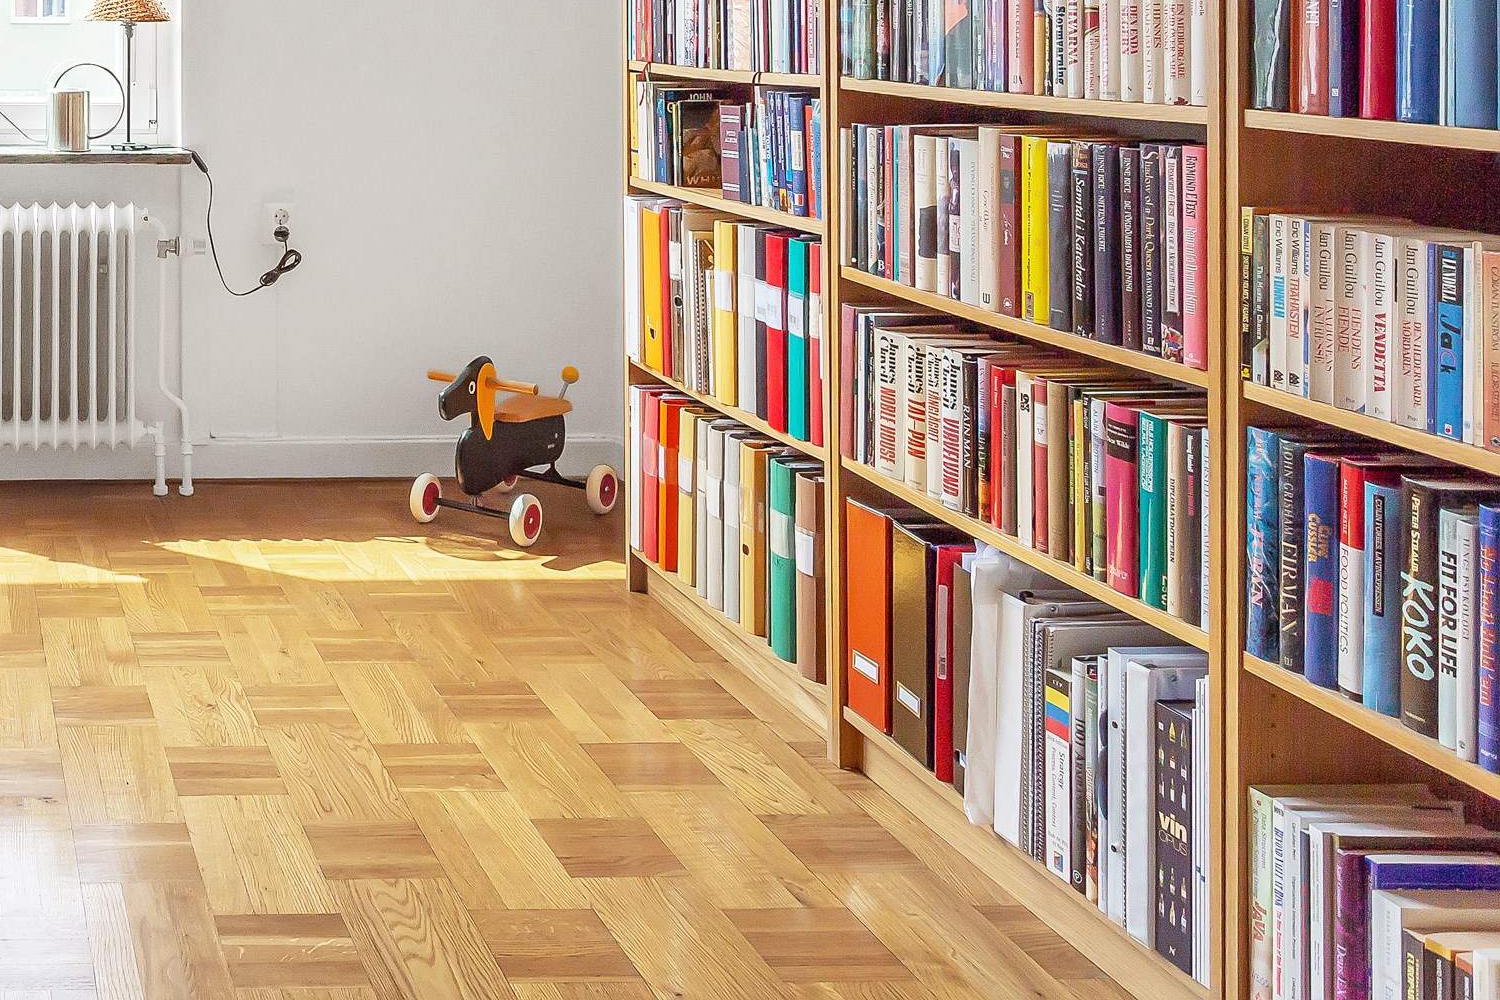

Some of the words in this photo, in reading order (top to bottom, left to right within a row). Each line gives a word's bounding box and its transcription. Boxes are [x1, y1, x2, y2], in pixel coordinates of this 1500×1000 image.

[1128, 5, 1138, 26] DEN
[1152, 8, 1162, 48] HENNES
[1176, 3, 1184, 16] EN
[1054, 6, 1066, 86] Stormvarning
[1128, 28, 1138, 54] ENDA
[1176, 18, 1184, 79] MEDBORGARE
[688, 93, 712, 101] JOHN
[1140, 150, 1158, 194] Shadow
[1184, 156, 1198, 192] RAYMOND
[1075, 177, 1086, 224] Samtal
[1144, 195, 1156, 208] of
[1184, 200, 1198, 218] FEIST
[1144, 216, 1156, 240] Dark
[1274, 220, 1283, 238] Eric
[1290, 220, 1300, 238] Eric
[1319, 229, 1332, 248] Jan
[1344, 230, 1358, 250] Jan
[1144, 241, 1156, 271] Queen
[1274, 238, 1283, 274] Williams
[1290, 238, 1300, 274] Williams
[1374, 238, 1386, 258] Jan
[1406, 245, 1419, 264] Jan
[1075, 234, 1086, 301] Katedralen
[1256, 265, 1264, 279] The
[1319, 248, 1332, 290] Guillou
[1344, 252, 1358, 298] Guillou
[1374, 260, 1386, 306] Guillou
[1441, 258, 1456, 302] LUNDELL
[1256, 281, 1264, 302] Music
[1274, 275, 1284, 318] TUNNELN
[1290, 276, 1300, 338] TRÄHÄSTEN
[1406, 268, 1419, 314] Guillou
[1256, 314, 1264, 340] Chance
[1314, 304, 1324, 364] INTRESSE
[1338, 304, 1350, 352] FIENDE
[1351, 307, 1362, 370] FIENDENS
[1414, 321, 1422, 342] DEN
[888, 338, 900, 384] James
[915, 347, 926, 394] James
[934, 354, 942, 388] James
[1374, 312, 1386, 393] VENDETTA
[950, 358, 960, 410] James
[880, 386, 896, 424] NOBLE
[963, 405, 971, 437] RAIN
[880, 426, 896, 465] HOUSE
[942, 417, 960, 498] VIRVELVIND
[963, 438, 971, 469] MAN
[1253, 430, 1264, 462] JOHN
[1283, 446, 1294, 478] JOHN
[1253, 464, 1264, 520] GRISHAM
[1283, 482, 1294, 535] GRISHAM
[1374, 498, 1384, 522] COLIN
[1411, 496, 1422, 528] PETER
[1308, 513, 1319, 562] CUSSLER
[1411, 530, 1422, 572] STRAUB
[1250, 527, 1264, 608] JURYN
[1340, 547, 1348, 593] FOOD
[1441, 550, 1458, 582] FIT
[1480, 544, 1496, 570] No
[1281, 540, 1298, 636] FIRMAN
[1462, 574, 1470, 640] PSYKOLOGI
[1480, 574, 1496, 624] Limit
[1340, 596, 1348, 654] POLITICS
[1400, 570, 1436, 681] KOKO
[1441, 585, 1458, 632] FOR
[1441, 635, 1458, 678] LIFE
[1480, 629, 1496, 706] Hold'em
[1074, 716, 1086, 746] 1001
[1057, 750, 1066, 790] Strategy
[1158, 810, 1188, 844] vin
[1158, 830, 1188, 856] OPUS
[1252, 815, 1260, 848] Problem
[1252, 849, 1260, 876] Solving
[1252, 877, 1260, 898] Using
[1252, 901, 1268, 942] JAVA
[1336, 943, 1348, 974] Deus
